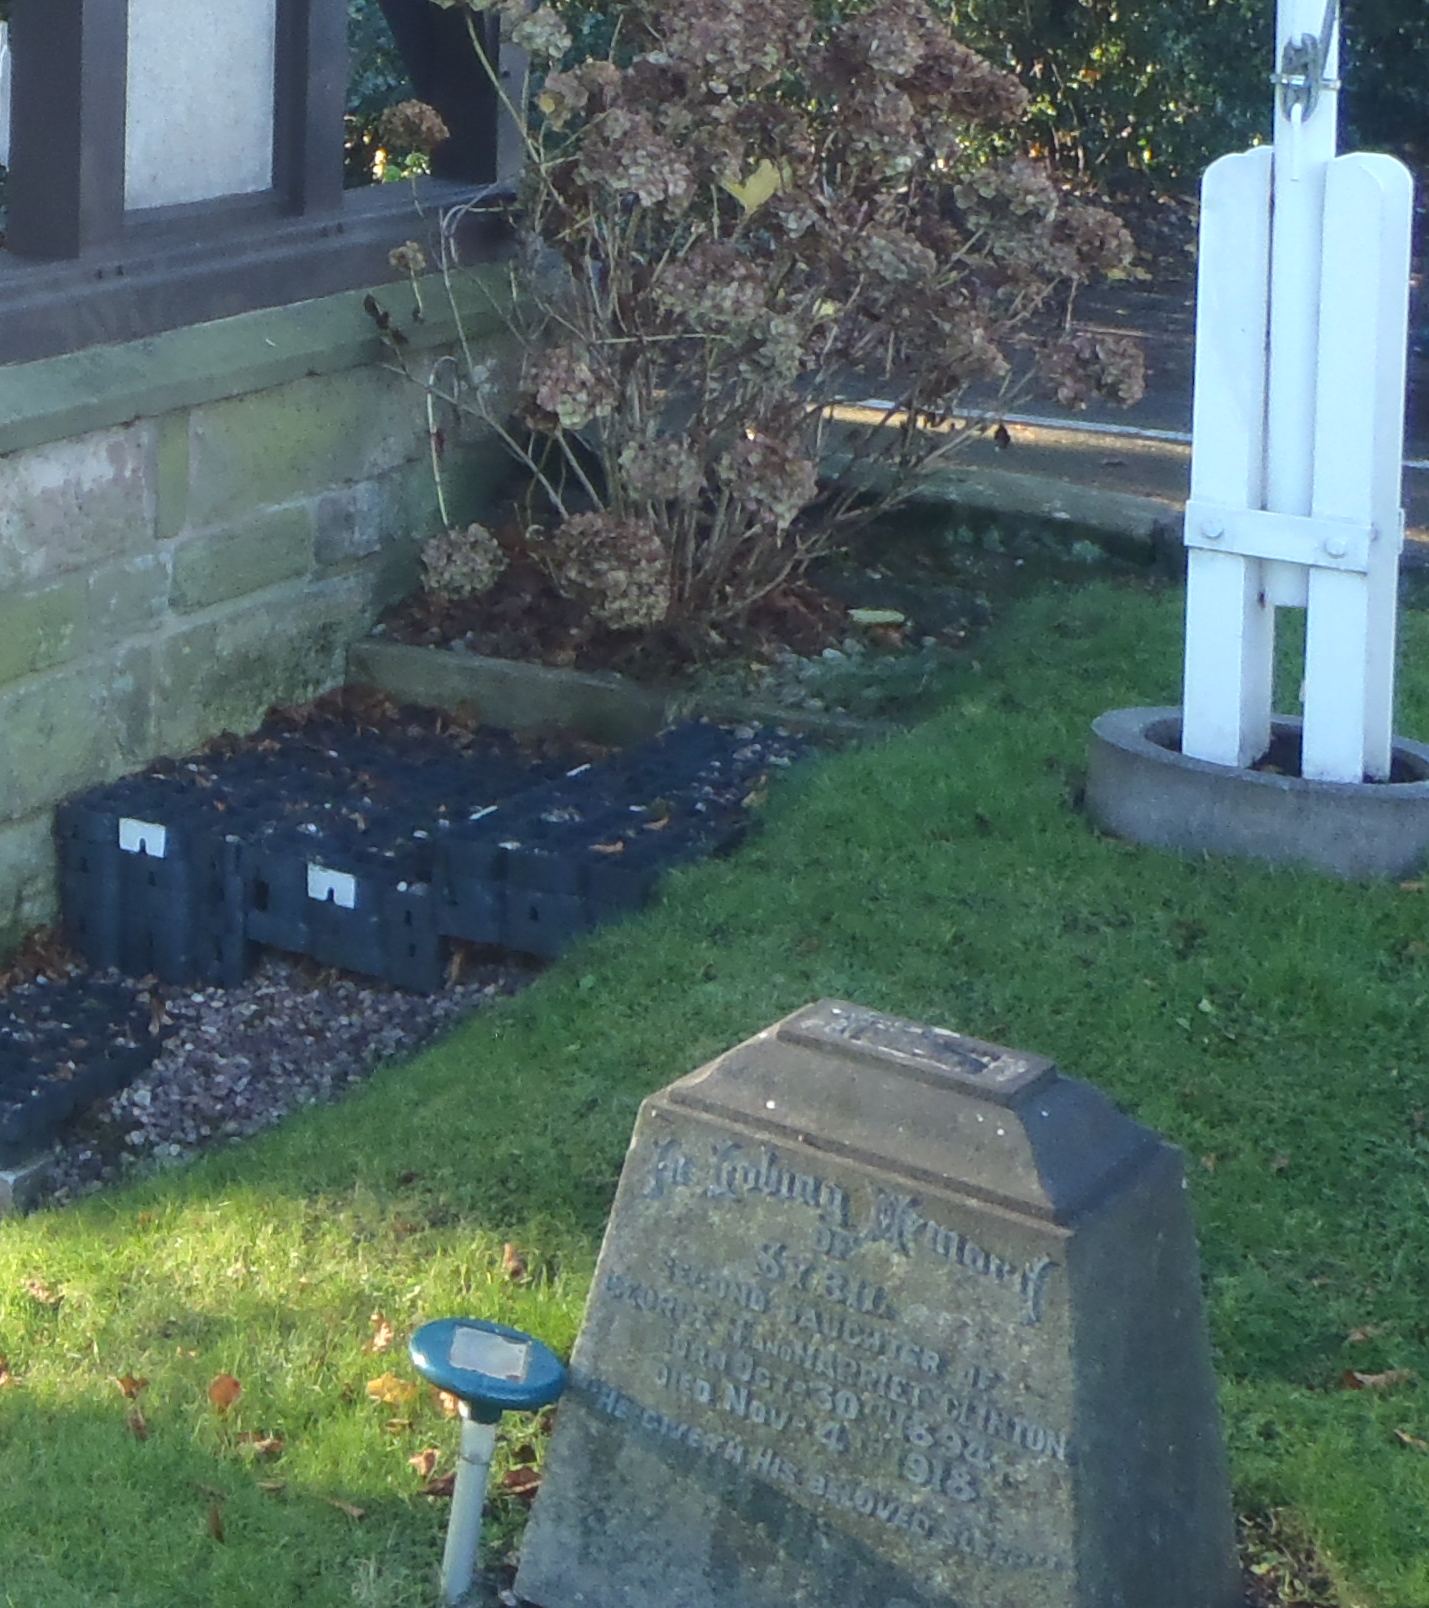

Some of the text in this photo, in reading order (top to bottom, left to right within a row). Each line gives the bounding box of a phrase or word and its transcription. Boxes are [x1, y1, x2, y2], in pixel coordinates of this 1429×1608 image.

[791, 1335, 921, 1407] HARRIET
[939, 1391, 1066, 1462] CLINTON
[888, 1443, 978, 1505] 918
